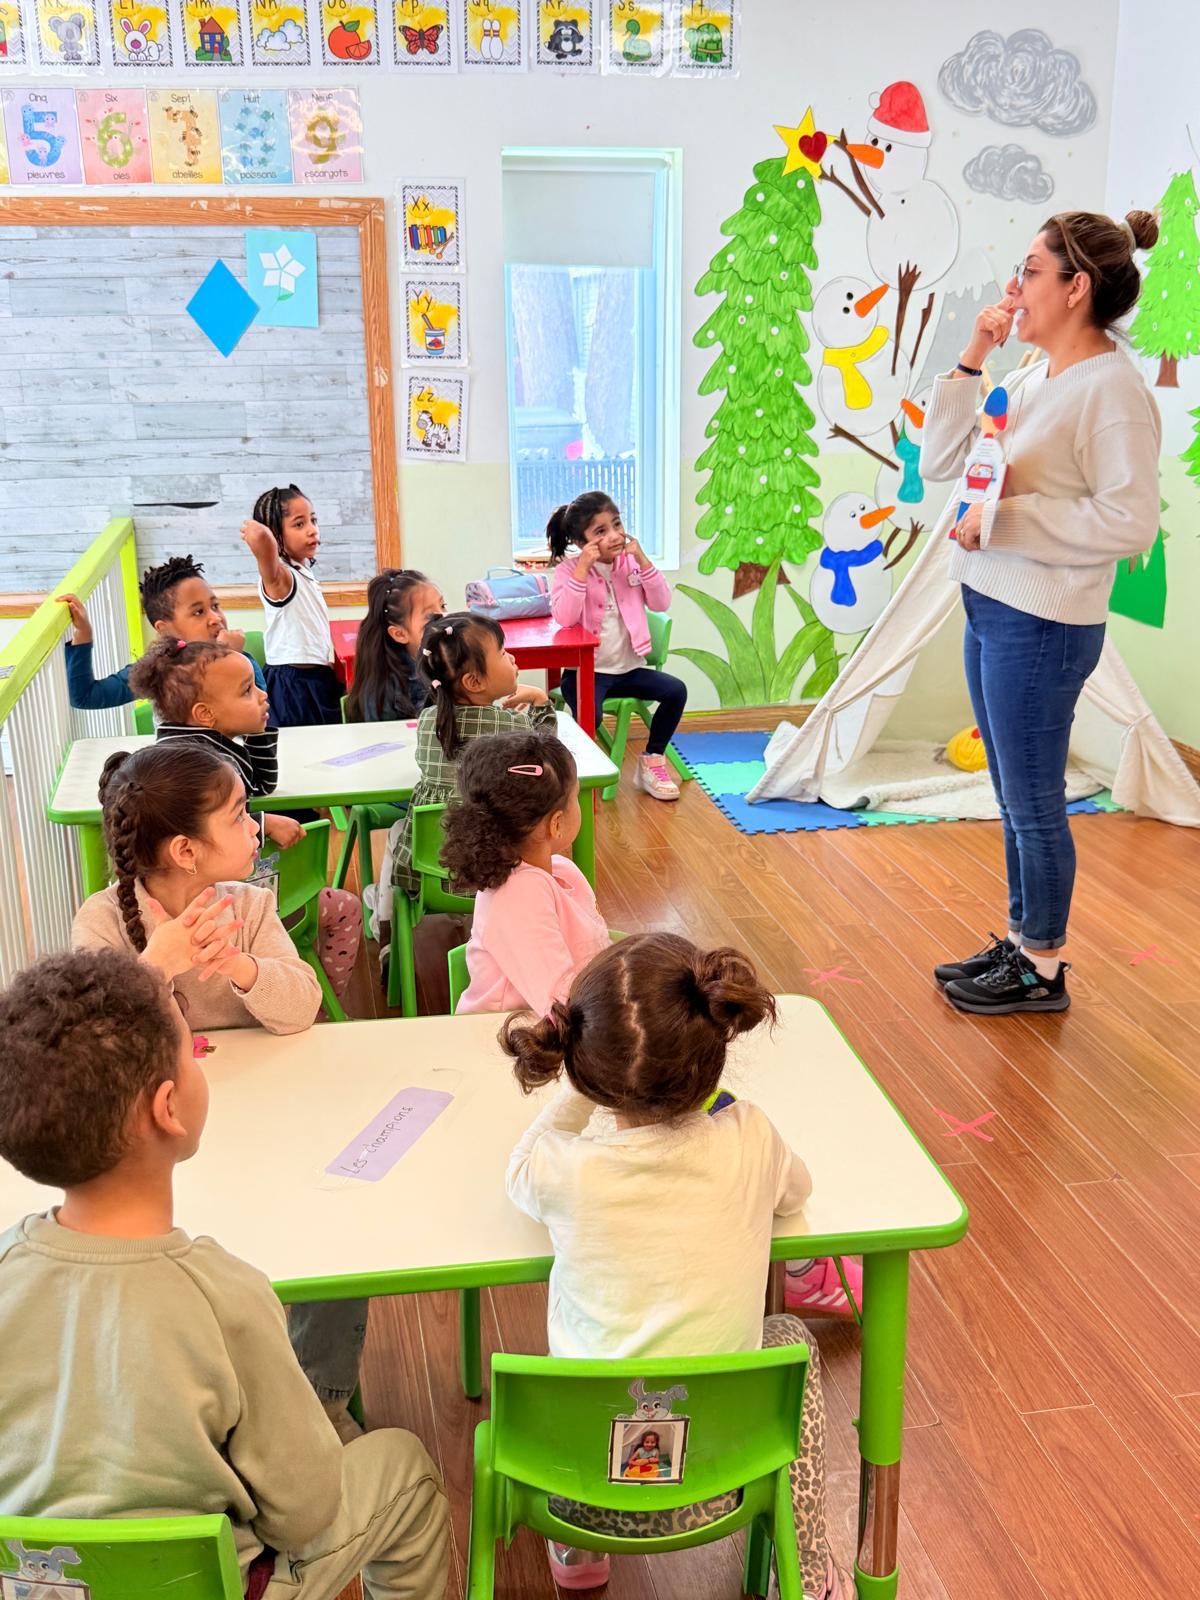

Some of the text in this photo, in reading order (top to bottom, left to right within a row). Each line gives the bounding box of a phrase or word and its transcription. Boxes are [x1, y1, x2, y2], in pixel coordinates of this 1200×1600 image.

[104, 93, 118, 103] Six
[171, 94, 191, 104] Sept
[243, 94, 261, 104] Huit
[23, 111, 62, 167] 5
[97, 111, 134, 168] 6
[165, 110, 201, 166] 7
[172, 170, 203, 179] abeilles
[240, 171, 277, 180] poissons
[304, 169, 349, 179] escargots
[411, 195, 430, 212] Xx
[412, 288, 433, 314] Yy
[417, 386, 435, 403] Zz
[340, 1158, 368, 1175] Les
